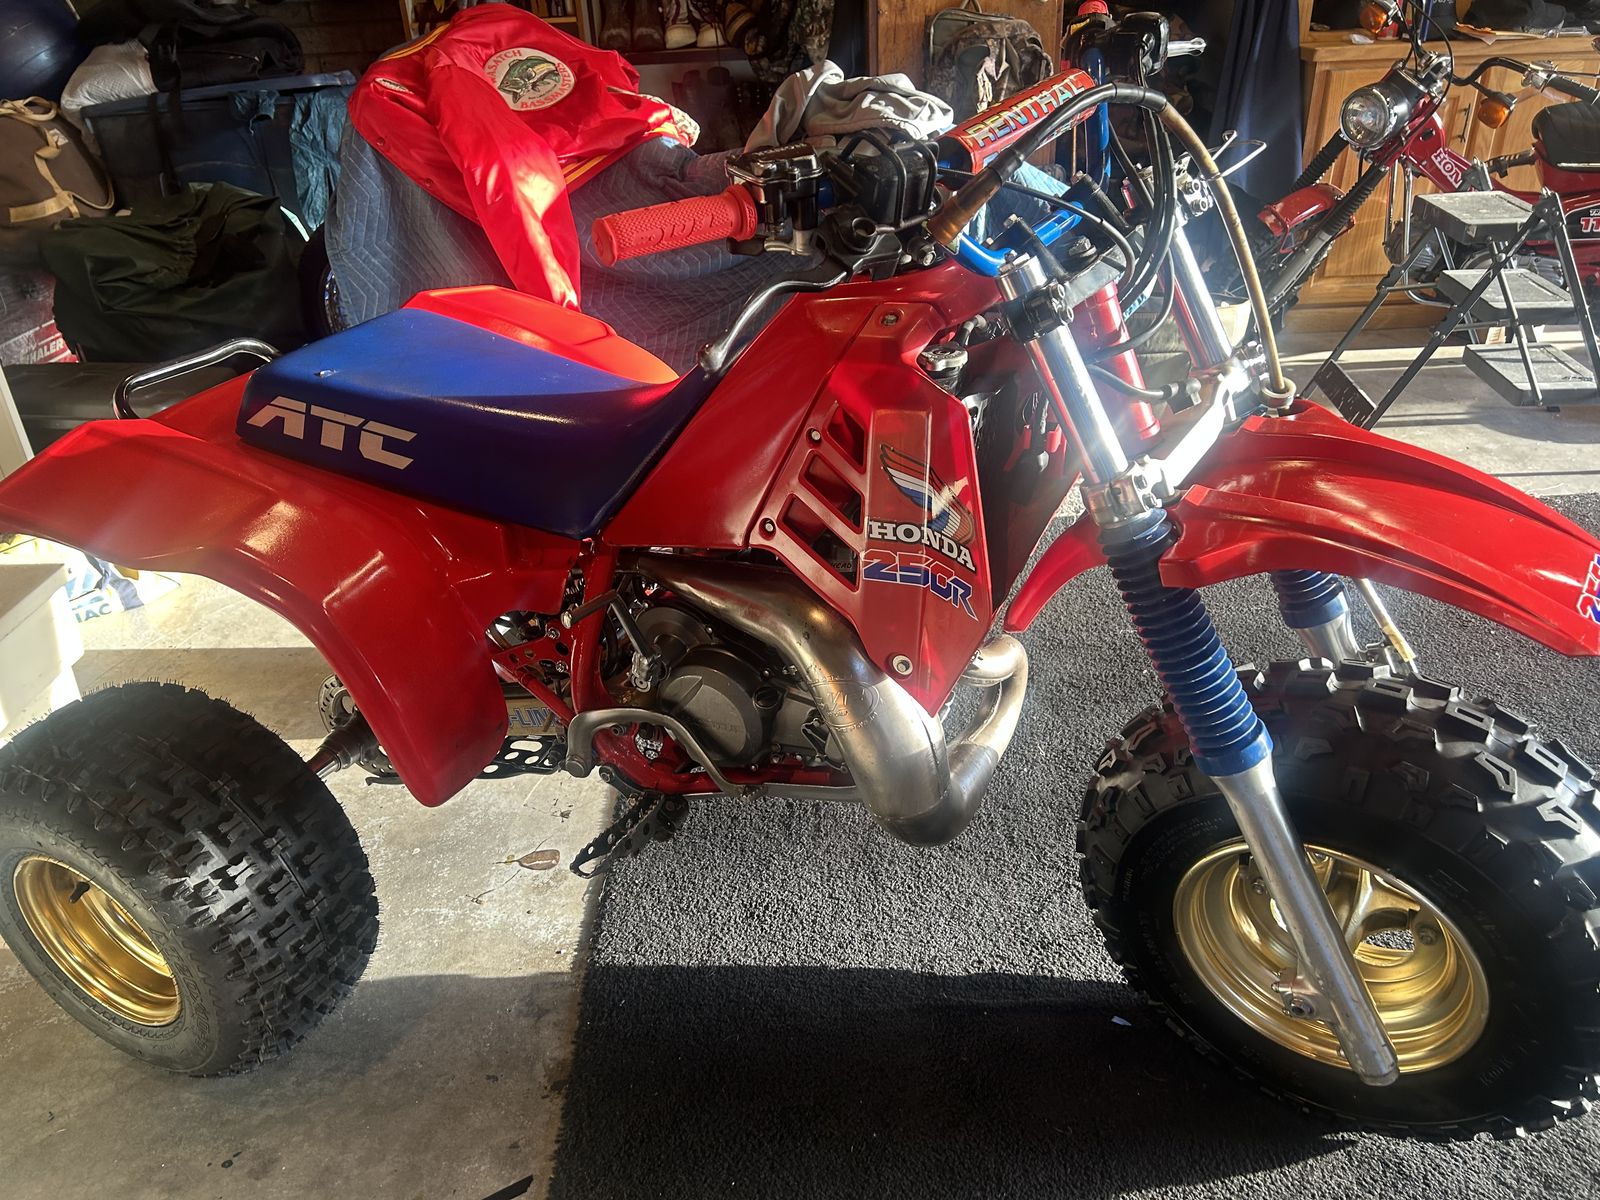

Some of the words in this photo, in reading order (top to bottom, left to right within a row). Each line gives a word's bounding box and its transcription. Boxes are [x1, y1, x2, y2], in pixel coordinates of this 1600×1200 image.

[520, 61, 572, 109] BASSMASTERS
[964, 77, 1086, 148] RENTHAL
[246, 395, 418, 470] ATC
[868, 520, 977, 572] HONDA
[861, 548, 979, 622] 250R
